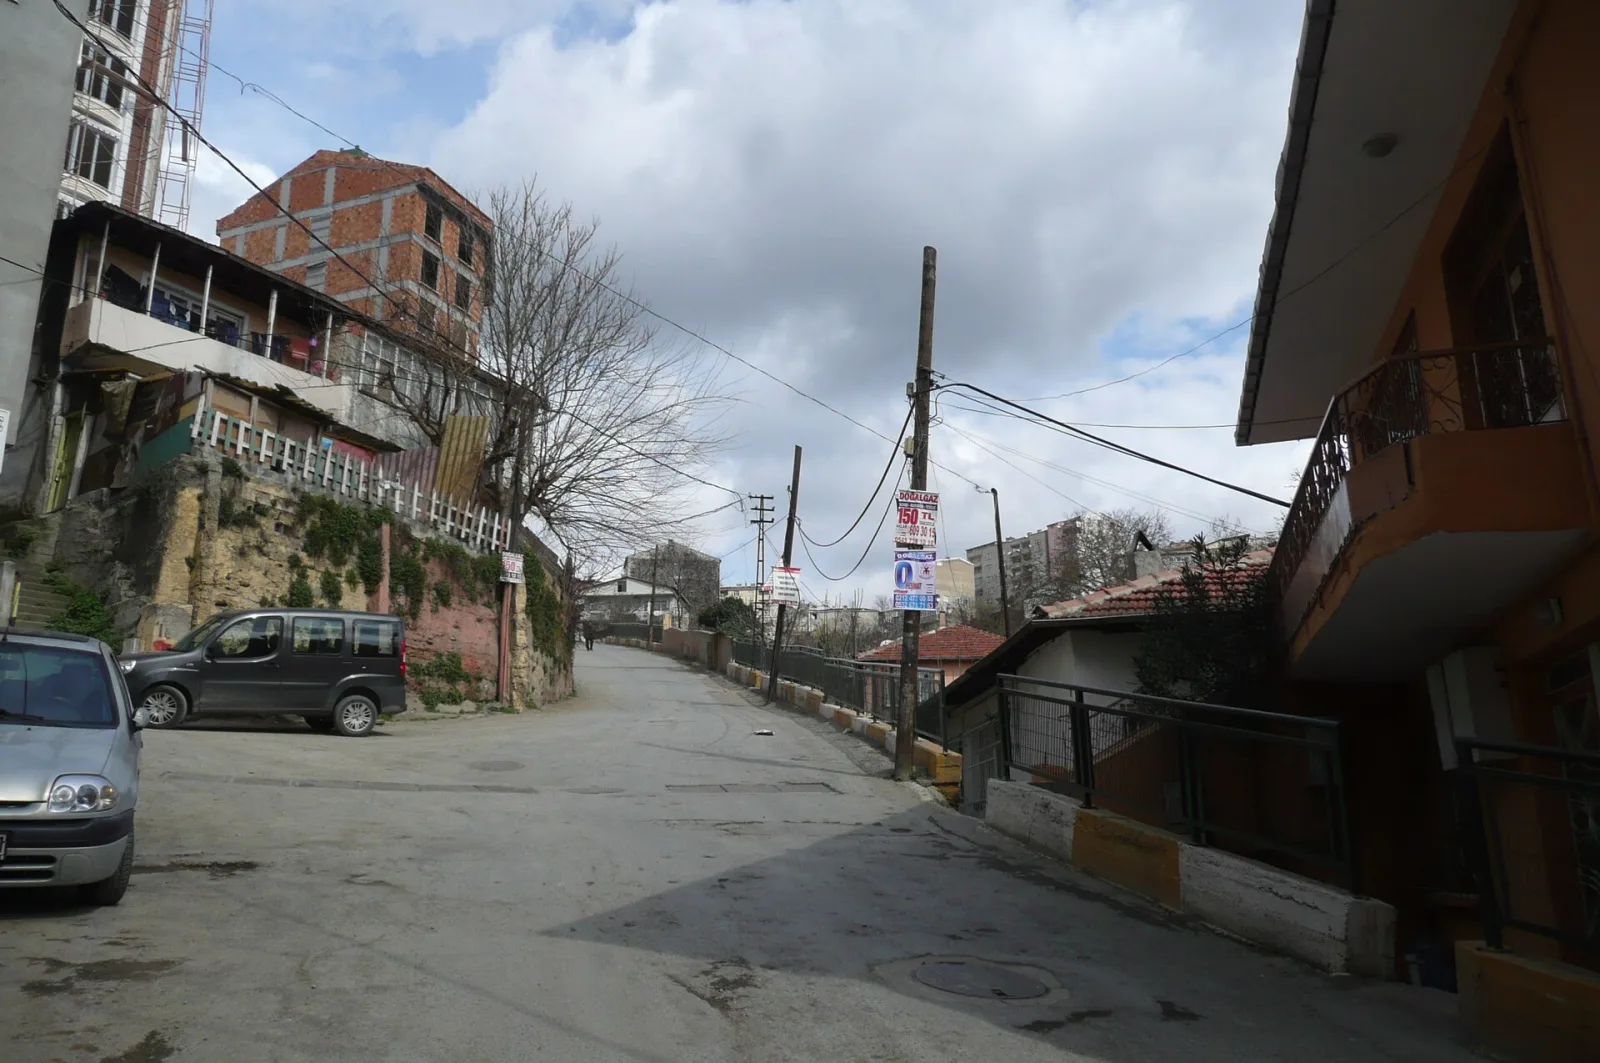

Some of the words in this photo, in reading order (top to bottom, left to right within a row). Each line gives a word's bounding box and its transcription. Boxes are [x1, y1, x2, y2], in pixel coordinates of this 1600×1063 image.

[899, 493, 939, 503] DOĞALGAZ
[898, 508, 919, 525] 150
[921, 512, 935, 521] TL
[895, 561, 912, 589] 0
